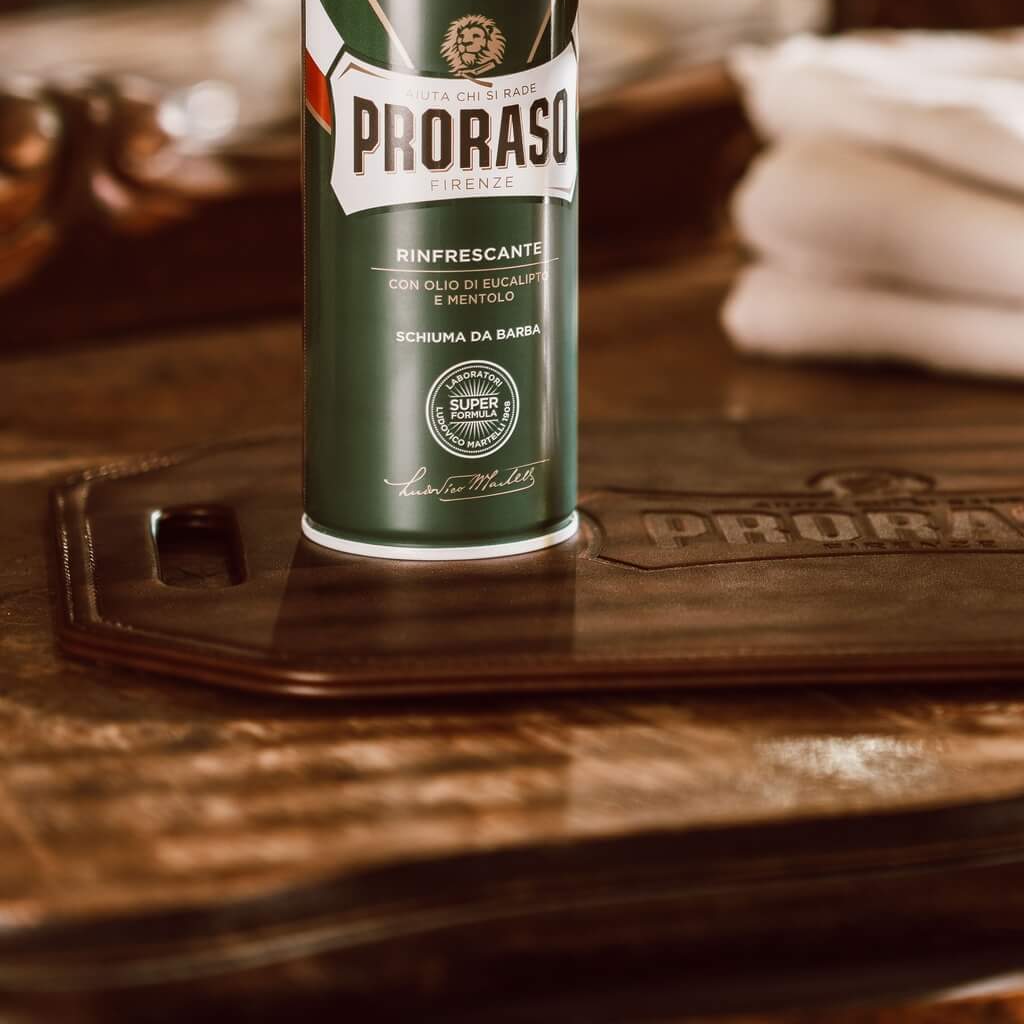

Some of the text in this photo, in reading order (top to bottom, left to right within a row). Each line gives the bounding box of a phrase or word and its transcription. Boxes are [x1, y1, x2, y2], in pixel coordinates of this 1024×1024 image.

[405, 83, 537, 102] AIUTA CHI SI RADE
[353, 88, 569, 176] PRORASO
[430, 176, 514, 192] FIRENZE
[396, 241, 543, 263] RINFRESCANTE
[388, 271, 549, 291] CON OLIO DI EUCALIPTO
[434, 291, 515, 306] E MENTOLO
[395, 324, 541, 343] SCHIUMA DA BARBA
[445, 370, 504, 390] LABORATORI
[449, 396, 499, 411] SUPER
[436, 400, 511, 448] LUDOVICO MARTELLI 1908
[450, 409, 498, 420] FORMULA
